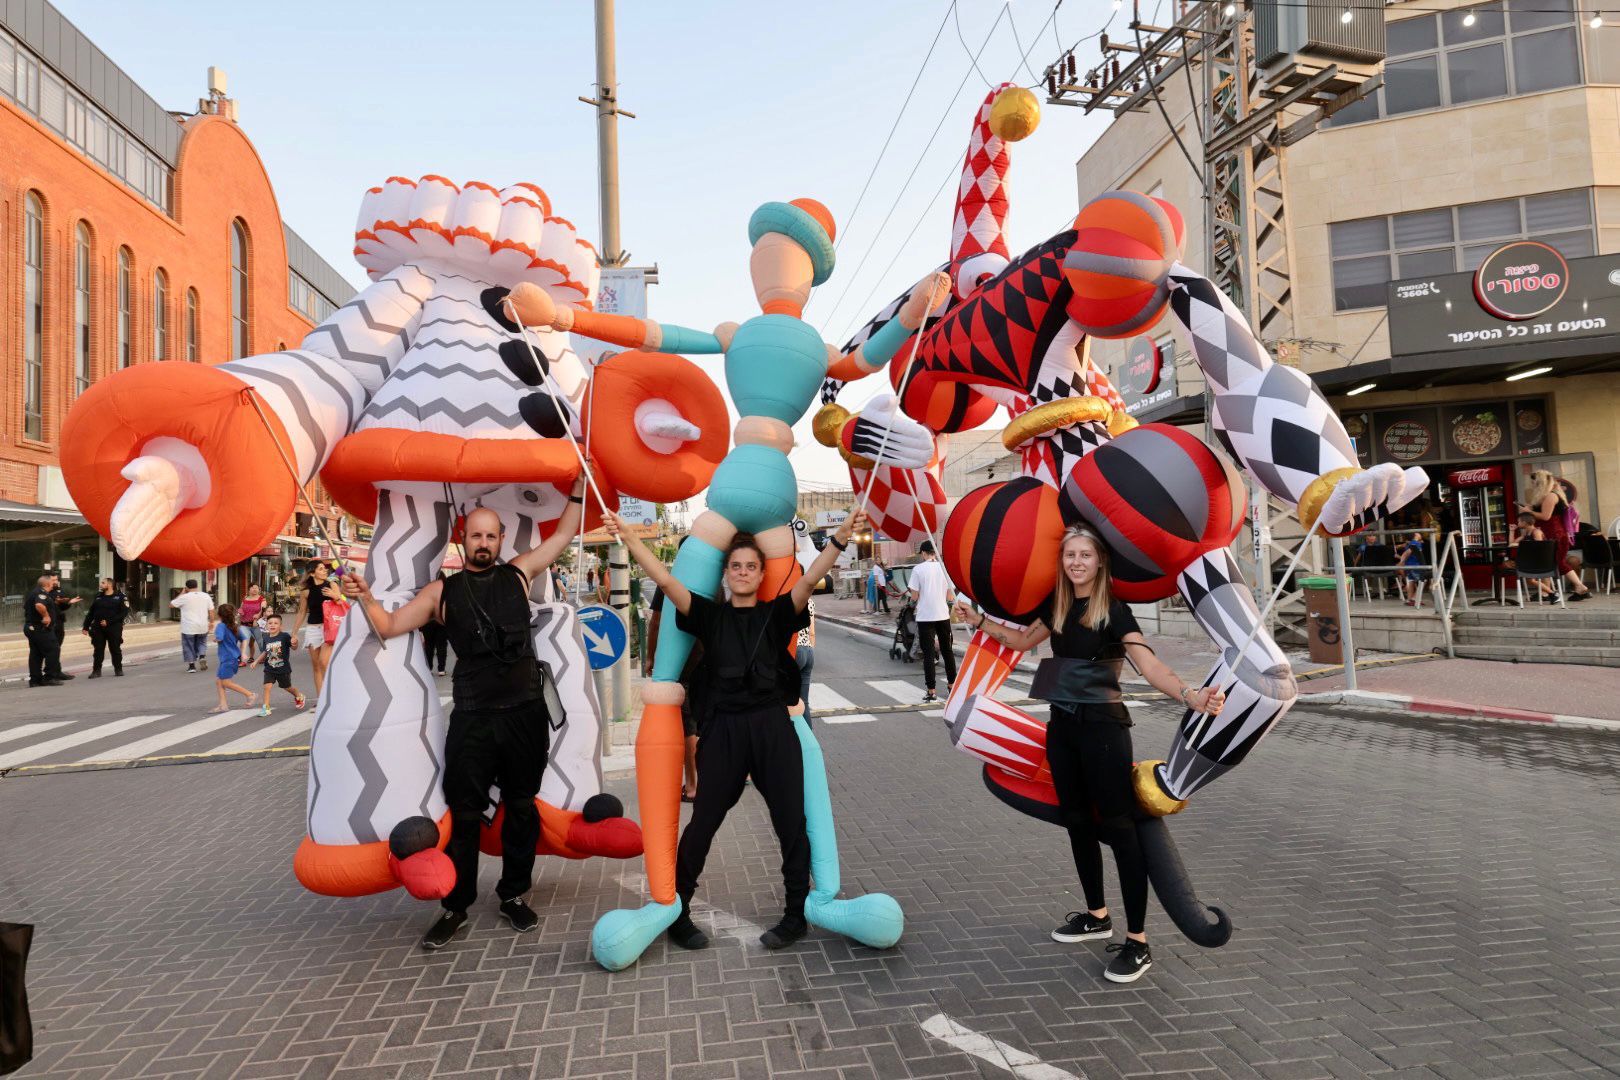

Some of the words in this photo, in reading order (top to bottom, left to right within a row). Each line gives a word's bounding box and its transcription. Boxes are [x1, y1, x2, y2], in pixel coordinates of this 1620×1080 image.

[1504, 263, 1540, 277] פיצה
[1486, 273, 1561, 294] סטורי
[1506, 324, 1528, 337] כל
[1533, 323, 1552, 335] זה
[1557, 317, 1607, 332] הטעם
[1447, 328, 1503, 343] הסיפור
